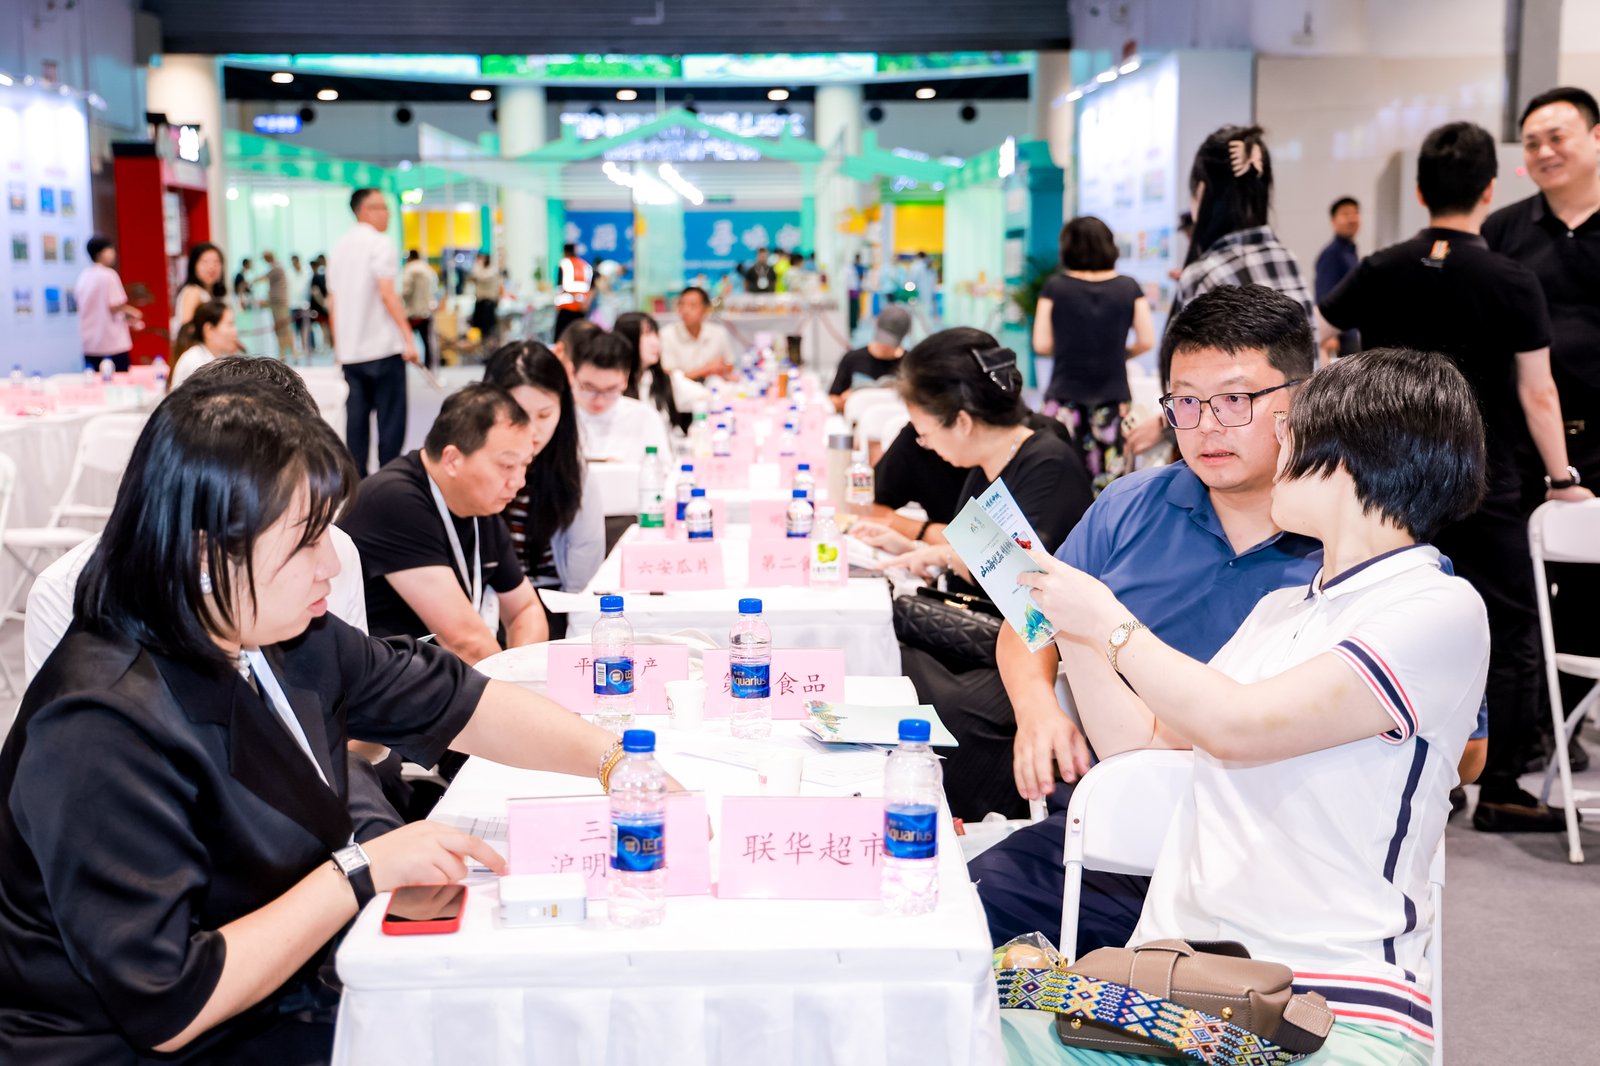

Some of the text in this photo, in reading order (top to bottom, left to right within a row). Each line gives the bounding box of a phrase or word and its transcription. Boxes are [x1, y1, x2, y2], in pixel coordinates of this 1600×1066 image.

[637, 557, 708, 575] 六安瓜片
[742, 832, 883, 867] 联华超市
